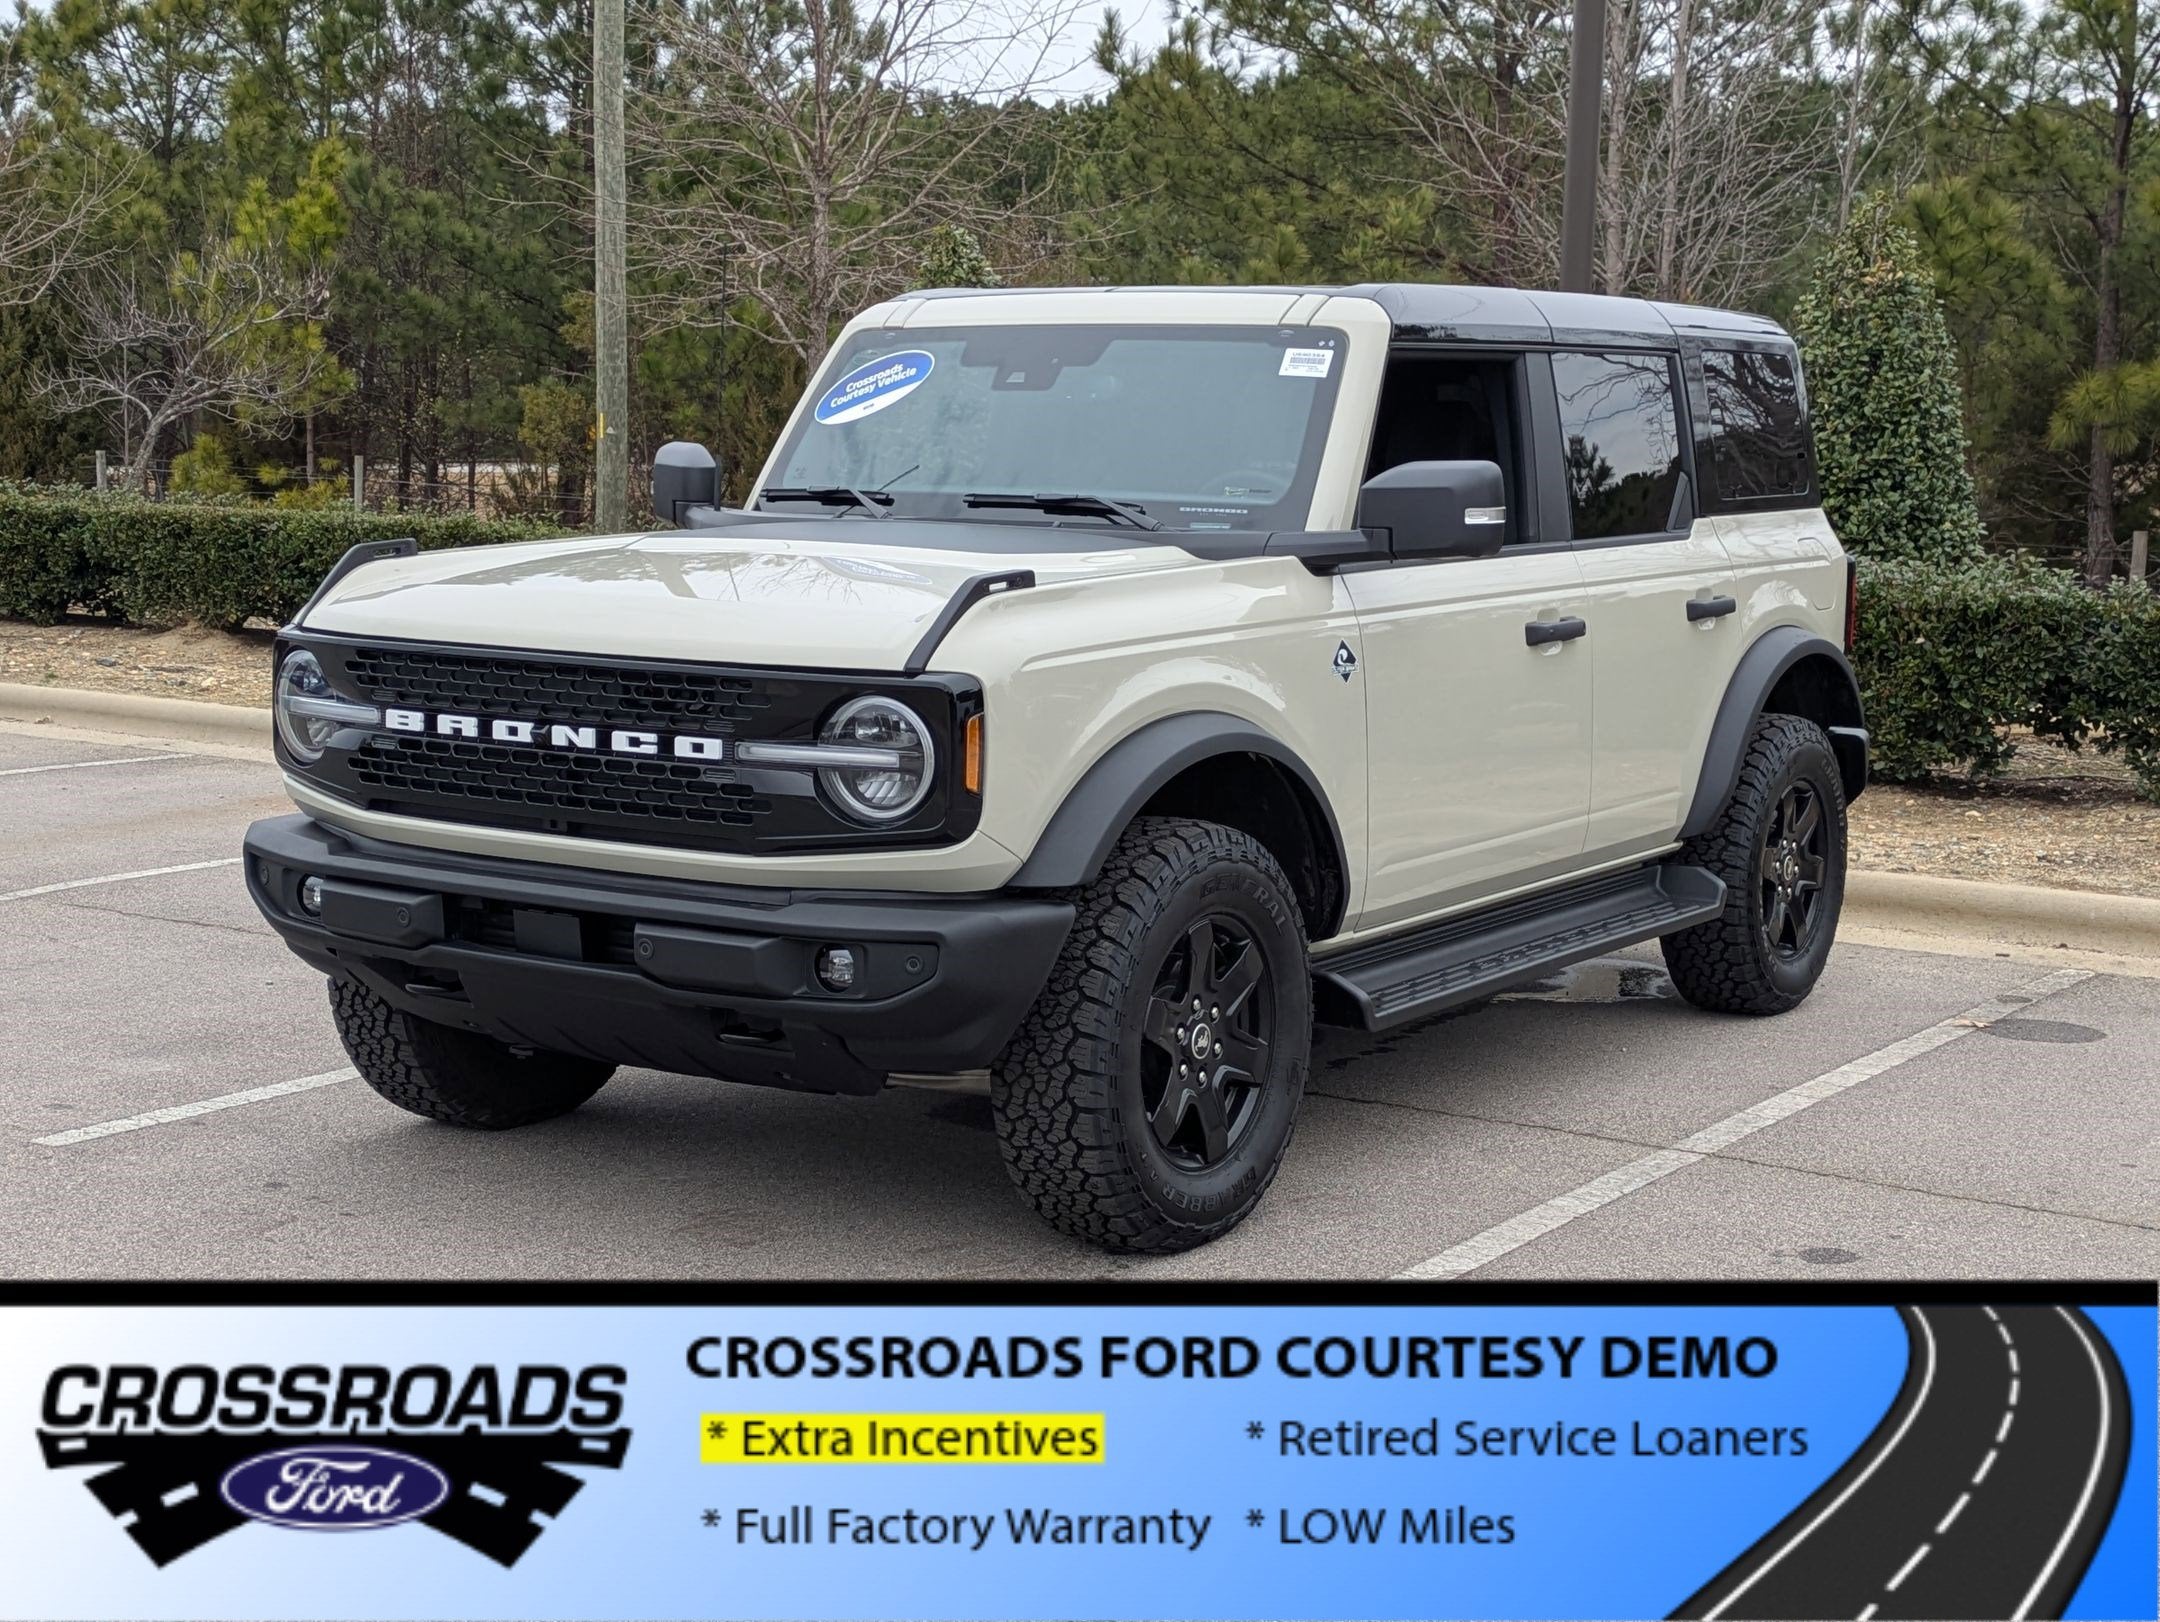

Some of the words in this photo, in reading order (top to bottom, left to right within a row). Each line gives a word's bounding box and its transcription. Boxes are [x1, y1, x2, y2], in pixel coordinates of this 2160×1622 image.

[830, 383, 876, 408] Courtesy
[878, 367, 917, 387] Vehicle
[845, 363, 904, 393] Crossroads
[385, 708, 723, 760] BRONCO
